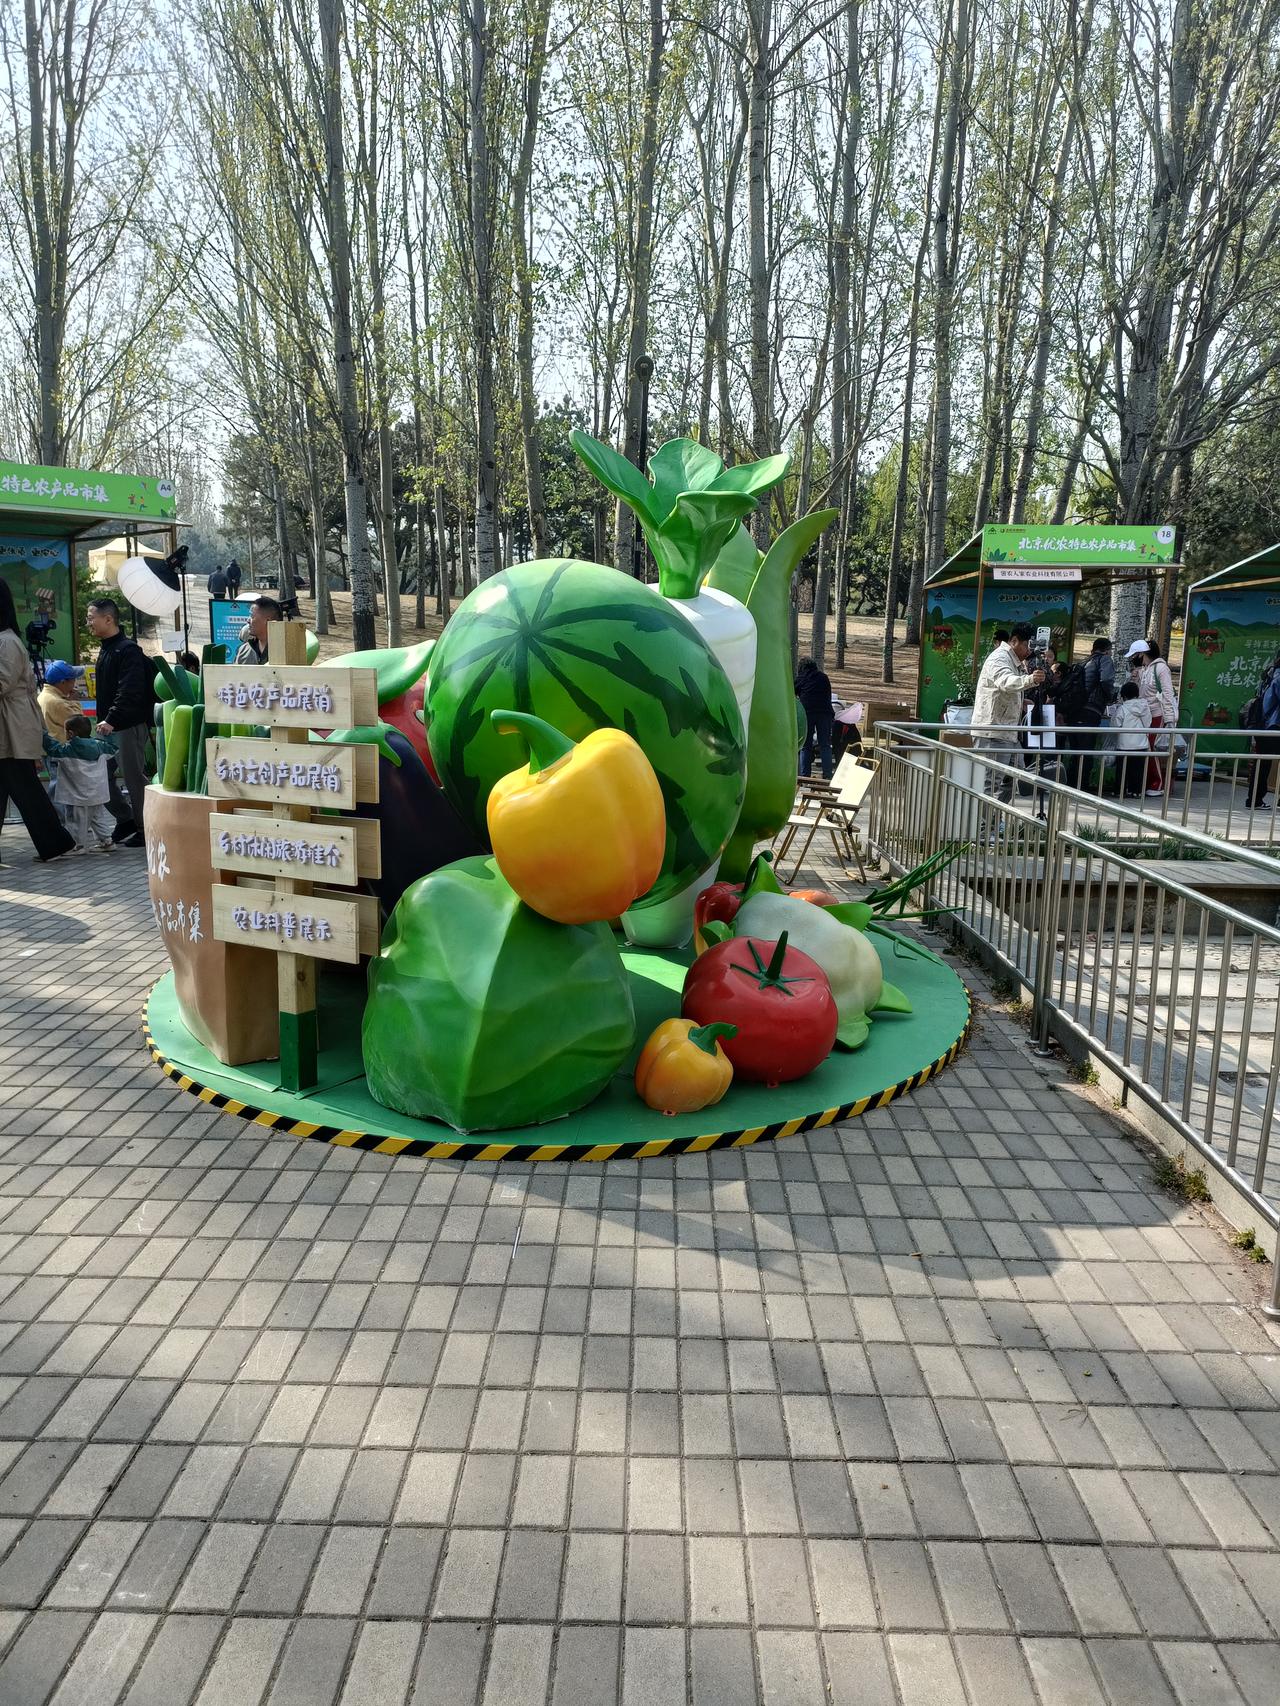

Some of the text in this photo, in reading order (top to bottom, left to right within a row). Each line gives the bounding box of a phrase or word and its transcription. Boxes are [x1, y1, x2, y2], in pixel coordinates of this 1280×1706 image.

[0, 475, 109, 502] 特色农产品市集
[160, 482, 172, 492] A4
[1018, 535, 1137, 552] 北京优农特色农产品市集
[1161, 530, 1172, 538] 18
[216, 682, 334, 713] 特色农产品展销
[215, 758, 342, 792] 乡村文创产品展销
[218, 831, 341, 867] 乡村休闲旅游推介
[232, 905, 333, 941] 农业科普展示
